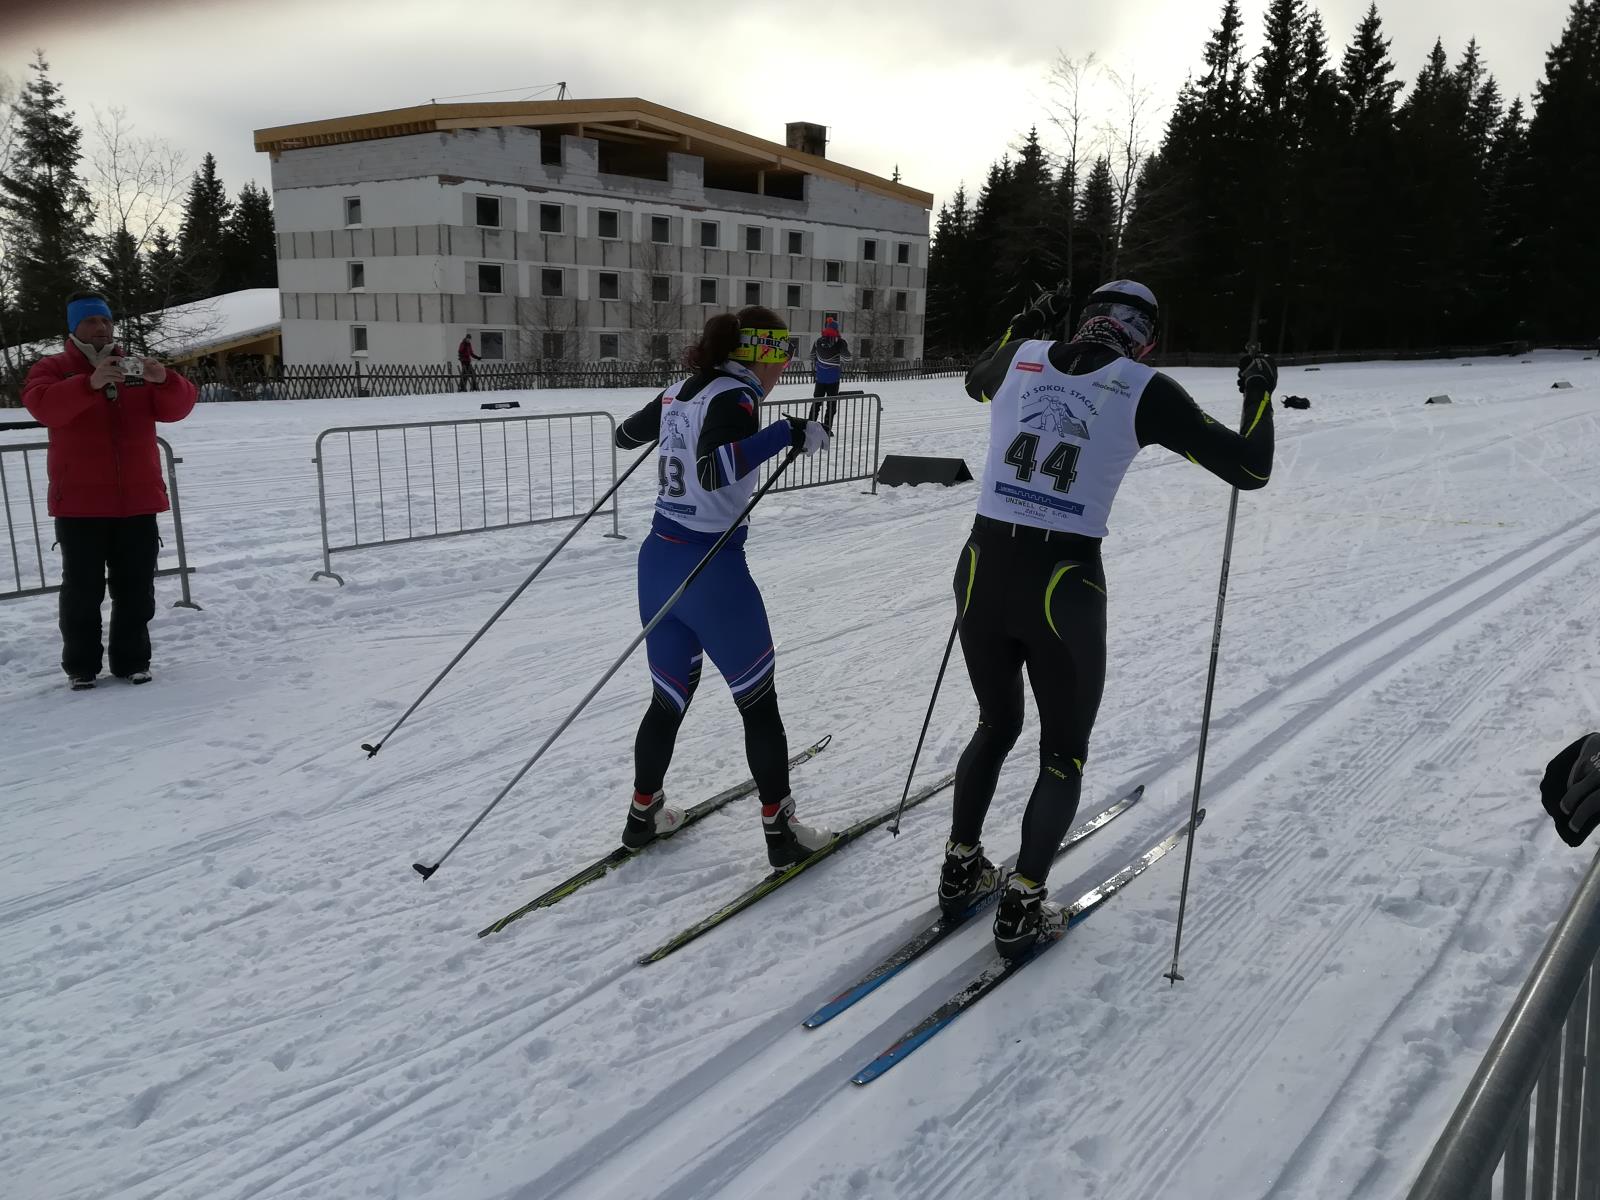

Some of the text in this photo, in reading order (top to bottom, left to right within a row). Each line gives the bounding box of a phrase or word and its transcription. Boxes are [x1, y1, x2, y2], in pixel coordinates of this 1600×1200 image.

[1020, 384, 1100, 416] TJ SOKOL STACHY
[1004, 431, 1082, 494] 44
[1005, 497, 1035, 508] UNIWELL
[1038, 505, 1049, 513] CZ
